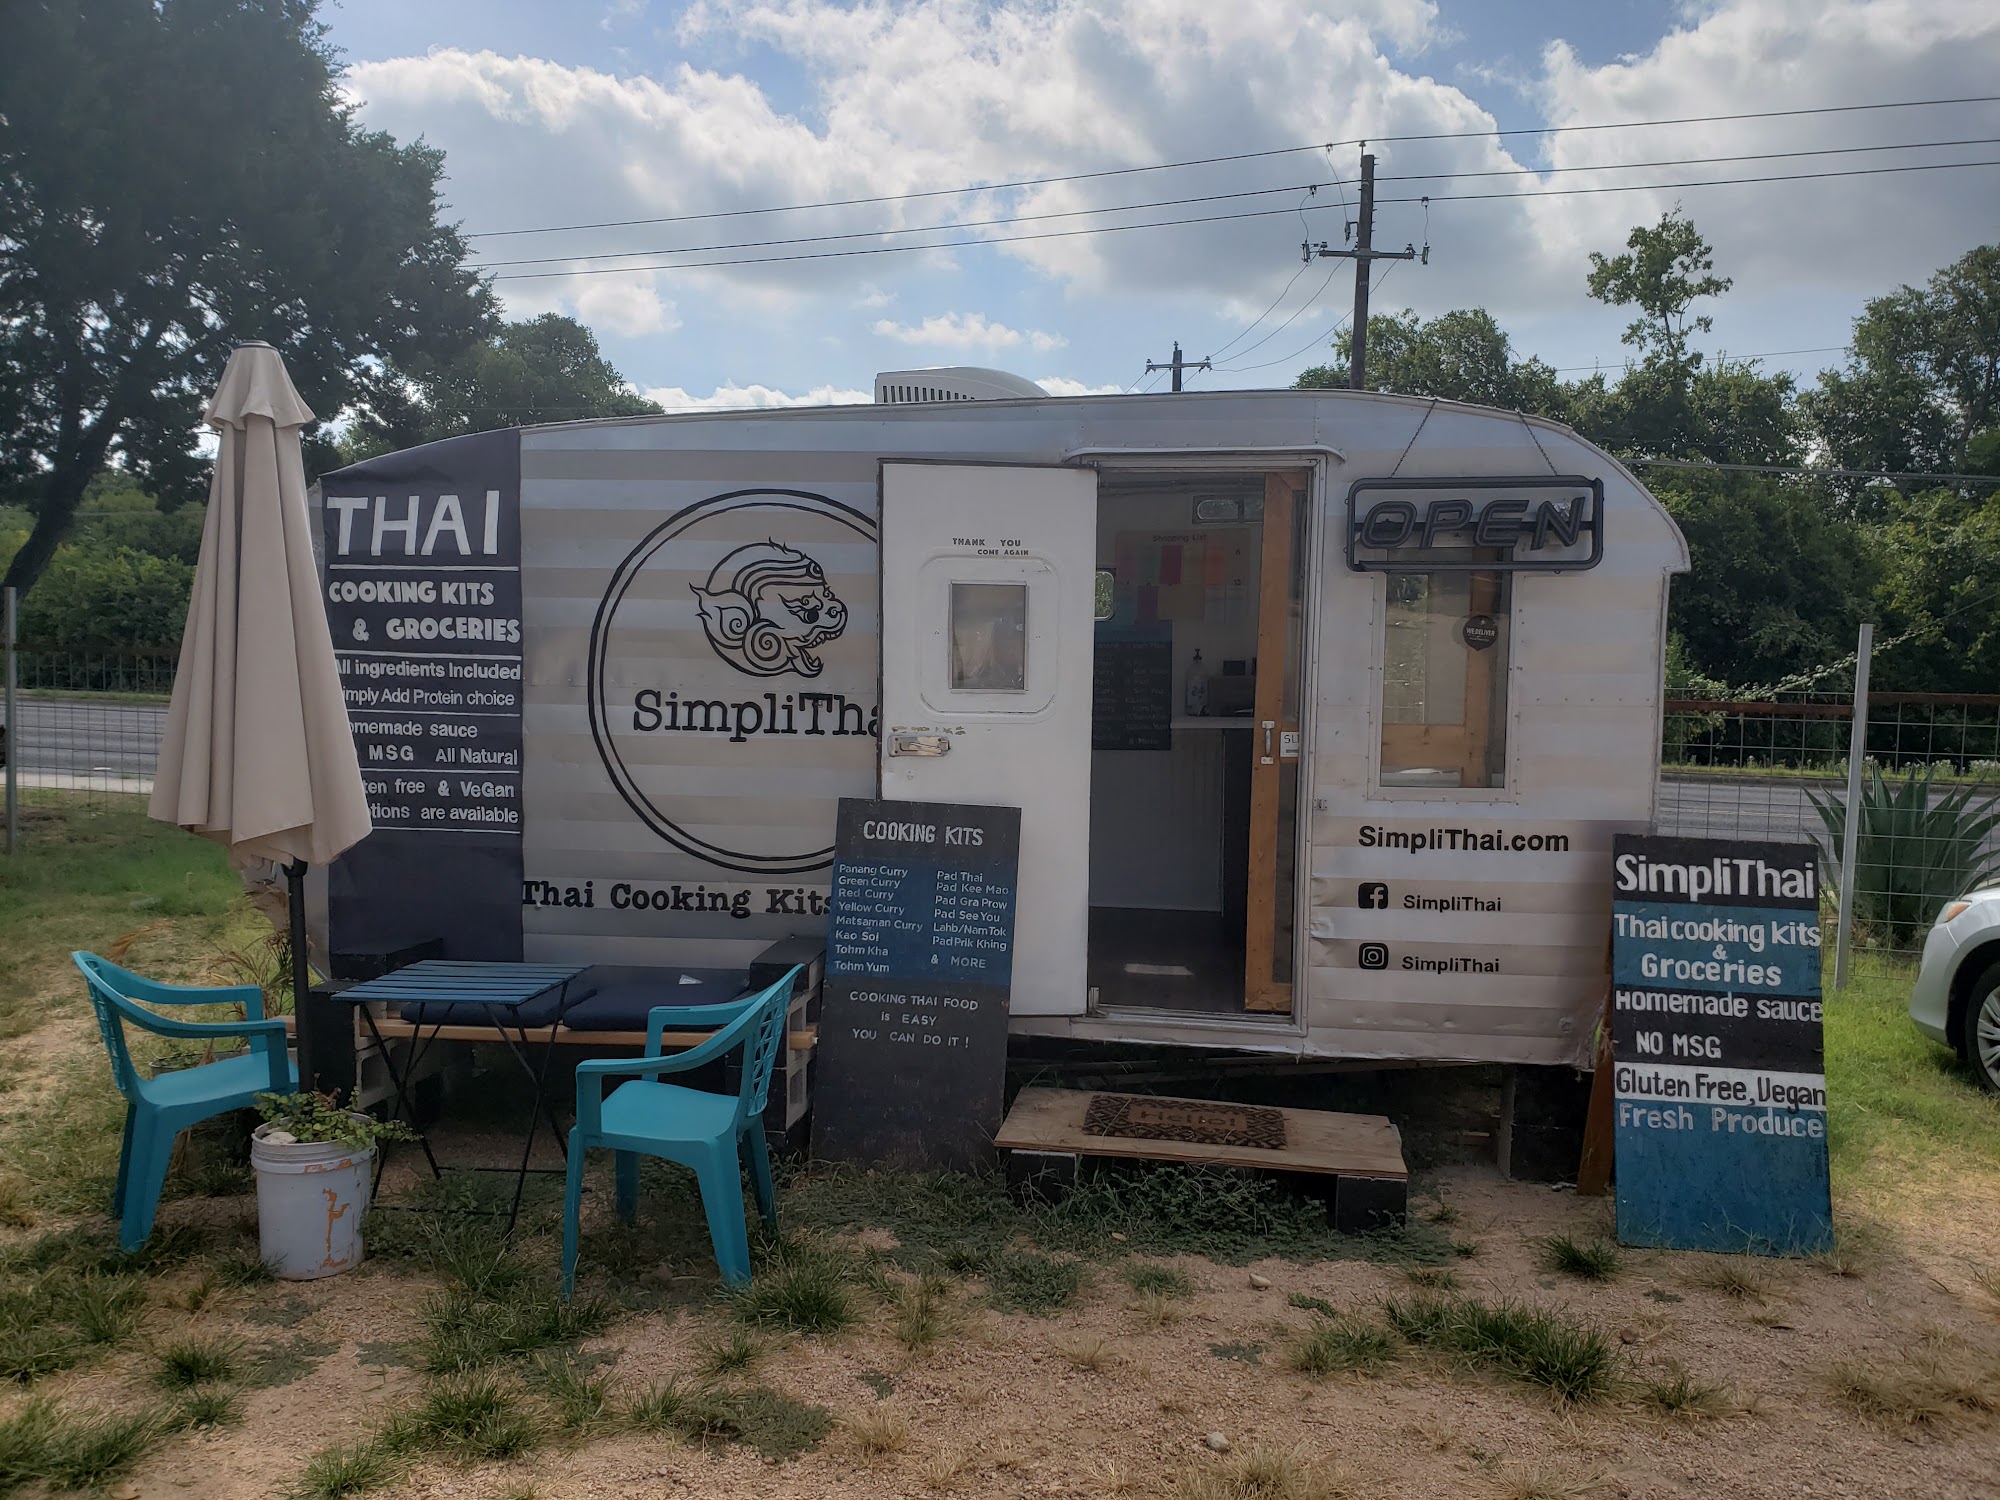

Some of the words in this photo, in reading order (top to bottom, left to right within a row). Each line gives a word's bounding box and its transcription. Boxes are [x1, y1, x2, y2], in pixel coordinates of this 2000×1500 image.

[327, 490, 499, 556] THAI
[1360, 497, 1586, 550] OPEN
[953, 538, 985, 546] THANK
[329, 582, 436, 603] COOKING
[442, 582, 494, 605] KITS
[353, 618, 370, 642] &
[386, 618, 520, 643] GROCERIES
[355, 660, 445, 678] ingredients
[450, 662, 520, 680] Included
[381, 689, 410, 703] Add
[414, 689, 462, 705] Protein
[467, 690, 515, 706] choice
[429, 724, 478, 738] sauce
[369, 745, 414, 761] MSG
[436, 748, 455, 763] All
[460, 749, 518, 765] Natural
[395, 778, 425, 794] free
[438, 780, 450, 796] &
[421, 807, 445, 820] are
[450, 808, 518, 824] available
[864, 821, 936, 843] COOKING
[945, 826, 984, 846] KITS
[1358, 826, 1569, 854] SimpliThai.com
[840, 864, 877, 876] Panang
[880, 866, 908, 878] Curry
[937, 871, 957, 881] Pad
[961, 872, 982, 882] Thai
[1615, 854, 1814, 902] SimpliThai
[838, 876, 869, 887] Green
[871, 878, 900, 888] Curry
[937, 882, 956, 892] Pad
[962, 883, 982, 894] Kee
[986, 885, 1009, 895] Mao
[523, 880, 594, 908] Thai
[611, 884, 751, 919] Cooking
[839, 888, 861, 898] Red
[865, 890, 894, 901] Curry
[935, 896, 956, 906] Pad
[960, 897, 979, 907] Gra
[982, 898, 1007, 910] Prow
[838, 902, 872, 913] Yellow
[875, 903, 905, 915] Curry
[1403, 895, 1501, 913] SimpliThai
[836, 915, 890, 928] Matsaman
[894, 920, 923, 932] Curry
[934, 909, 955, 919] Pad
[959, 910, 978, 921] See
[981, 911, 1000, 923] You
[835, 930, 857, 940] Kao
[1771, 921, 1822, 947] kits
[835, 944, 865, 955] Tohm
[868, 946, 889, 956] Kha
[932, 936, 953, 946] Pad
[977, 939, 1007, 951] Khing
[1712, 944, 1728, 960] &
[835, 961, 864, 972] Tohm
[866, 962, 890, 973] Yum
[931, 954, 939, 964] &
[951, 957, 986, 968] MORE
[1402, 956, 1500, 974] SimpliThai
[1641, 953, 1782, 986] Groceries
[850, 991, 906, 1004] COOKING
[911, 995, 938, 1006] THAI
[944, 997, 978, 1011] FOOD
[1616, 990, 1748, 1017] Homemade
[1757, 999, 1823, 1022] sauce
[902, 1014, 937, 1026] EASY
[853, 1028, 877, 1040] YOU
[890, 1032, 914, 1043] CAN
[923, 1034, 941, 1045] DO
[1636, 1031, 1663, 1055] NO
[1673, 1034, 1721, 1059] MSG
[1616, 1068, 1690, 1098] Gluten
[1620, 1103, 1694, 1130] Fresh
[1712, 1107, 1823, 1137] Produce
